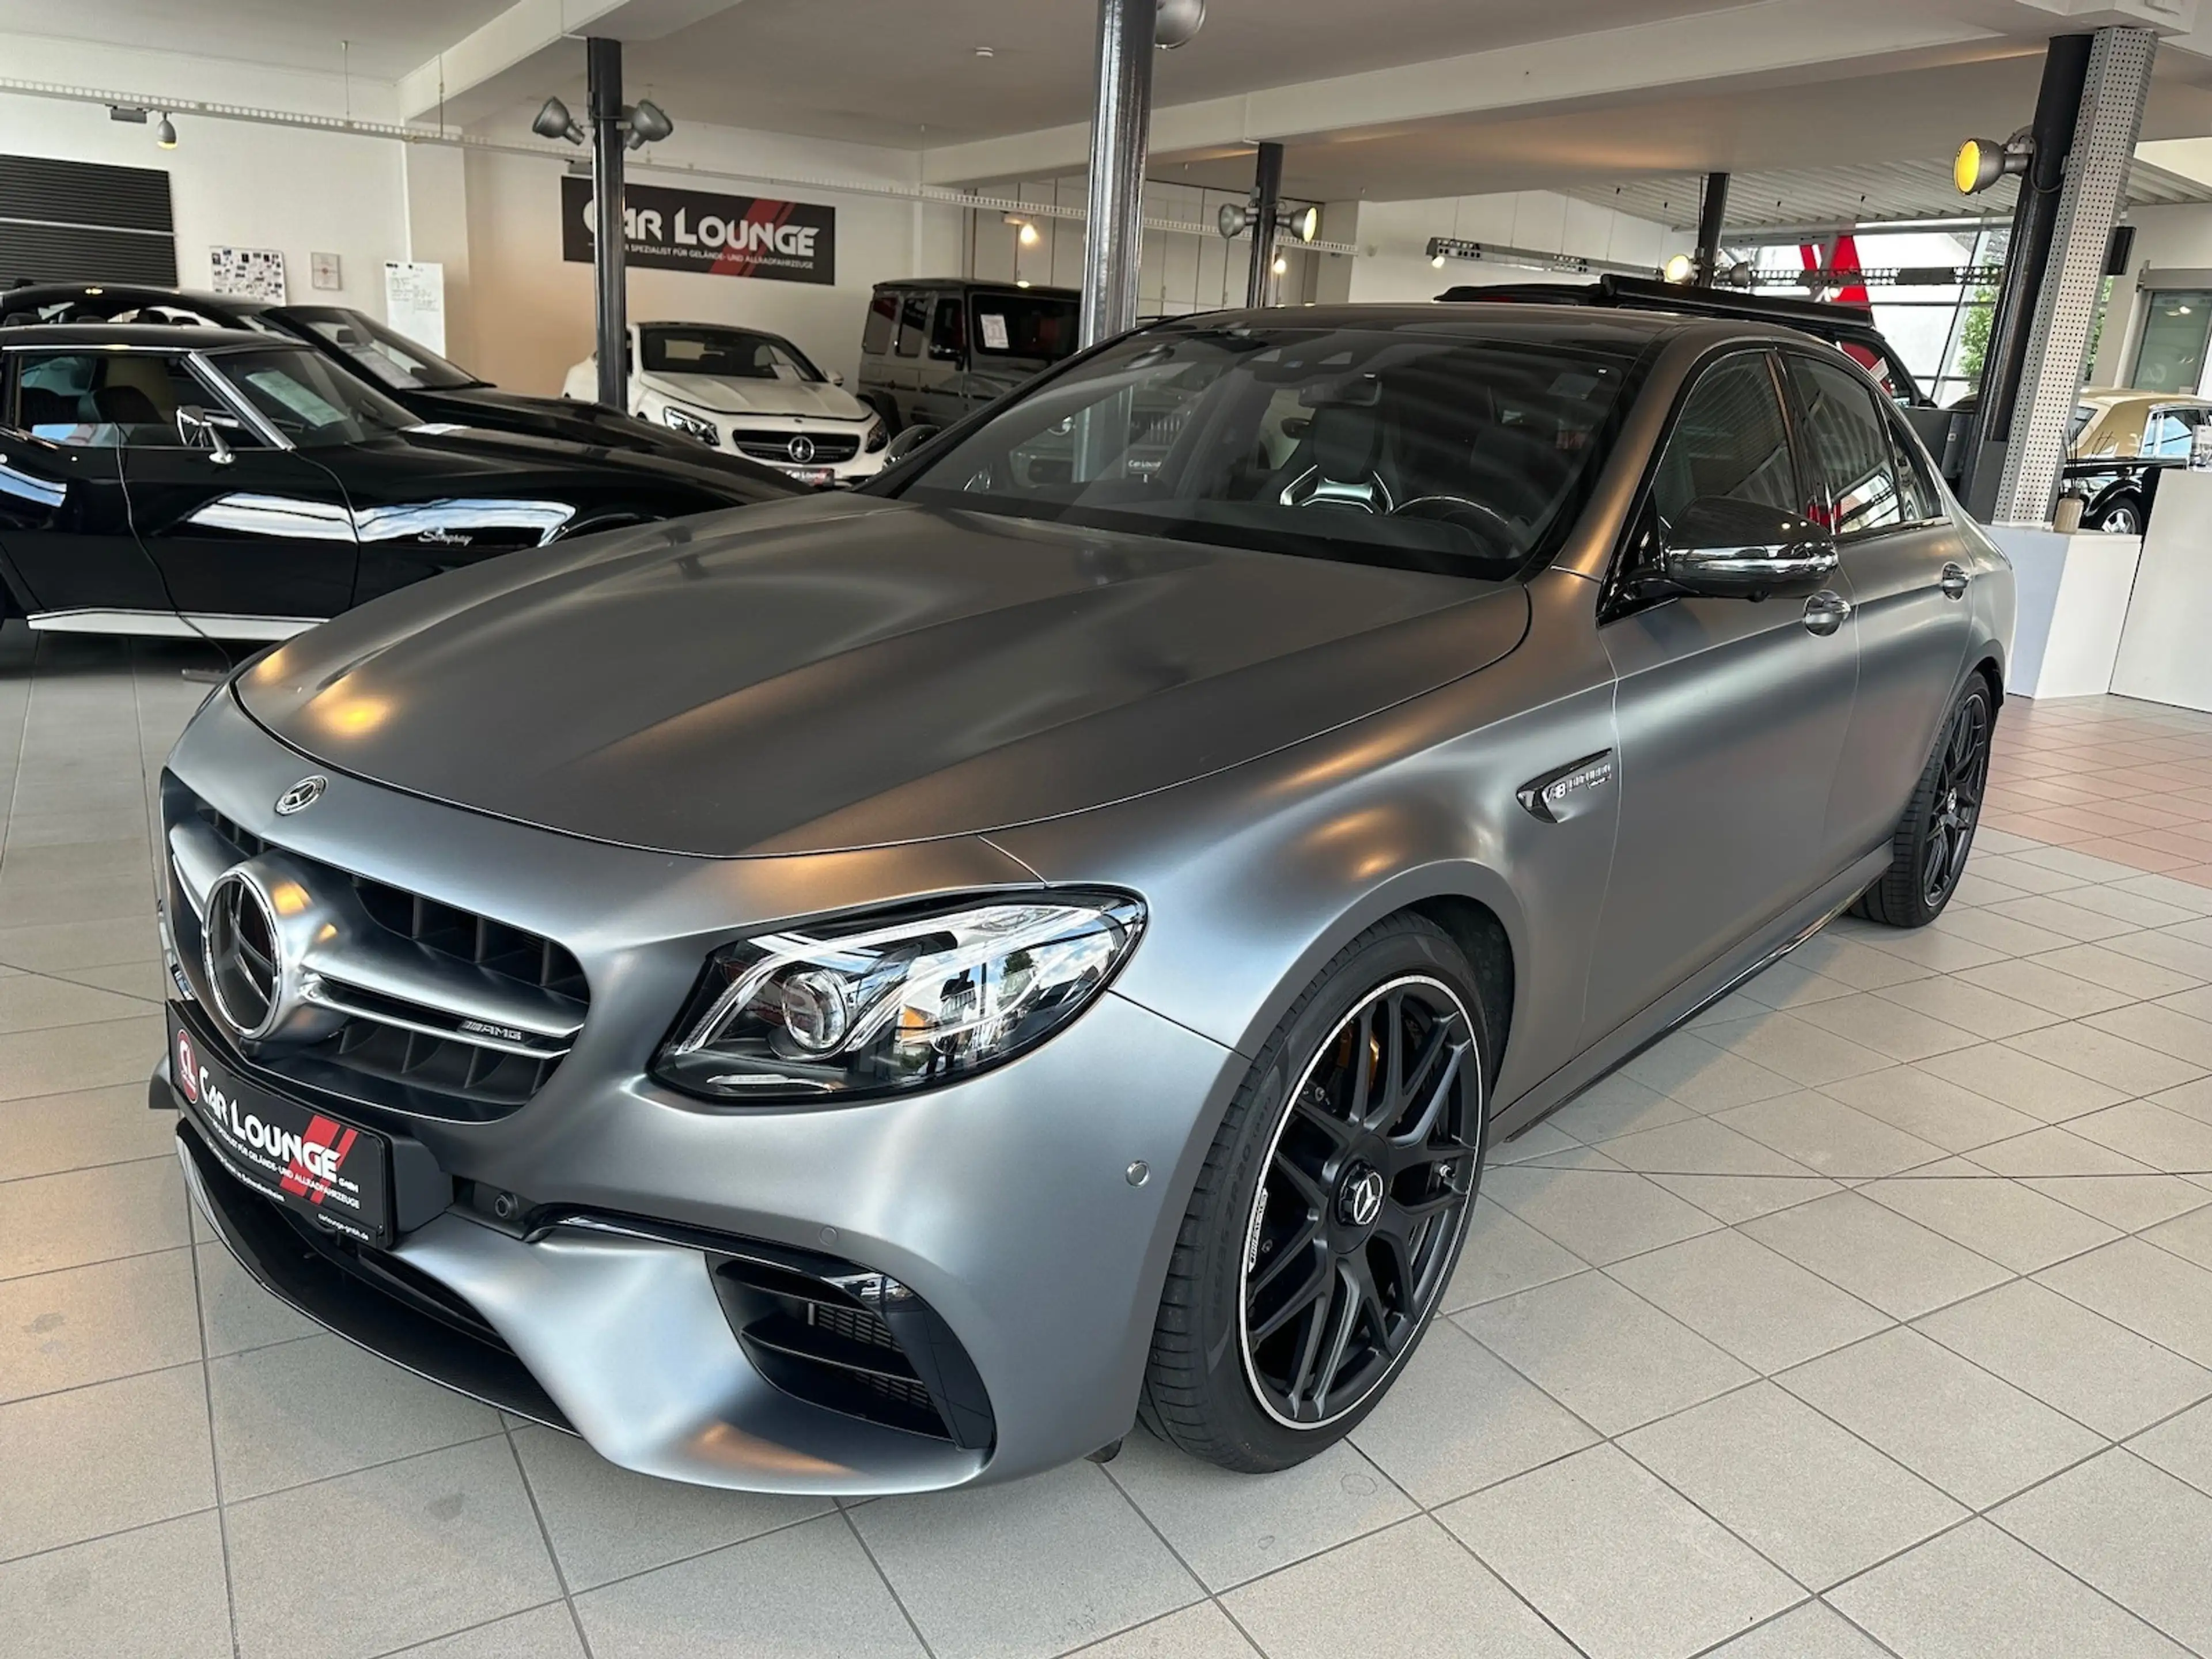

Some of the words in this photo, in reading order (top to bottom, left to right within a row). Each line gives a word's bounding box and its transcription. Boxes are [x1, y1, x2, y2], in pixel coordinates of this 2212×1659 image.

[675, 208, 820, 256] LOUNGE
[631, 245, 672, 255] SPEZIALIST
[673, 247, 687, 257] FÜR
[728, 255, 744, 263] UND
[481, 1024, 521, 1040] AMG
[199, 1066, 229, 1127] CAR
[230, 1099, 341, 1182] LOUNGE
